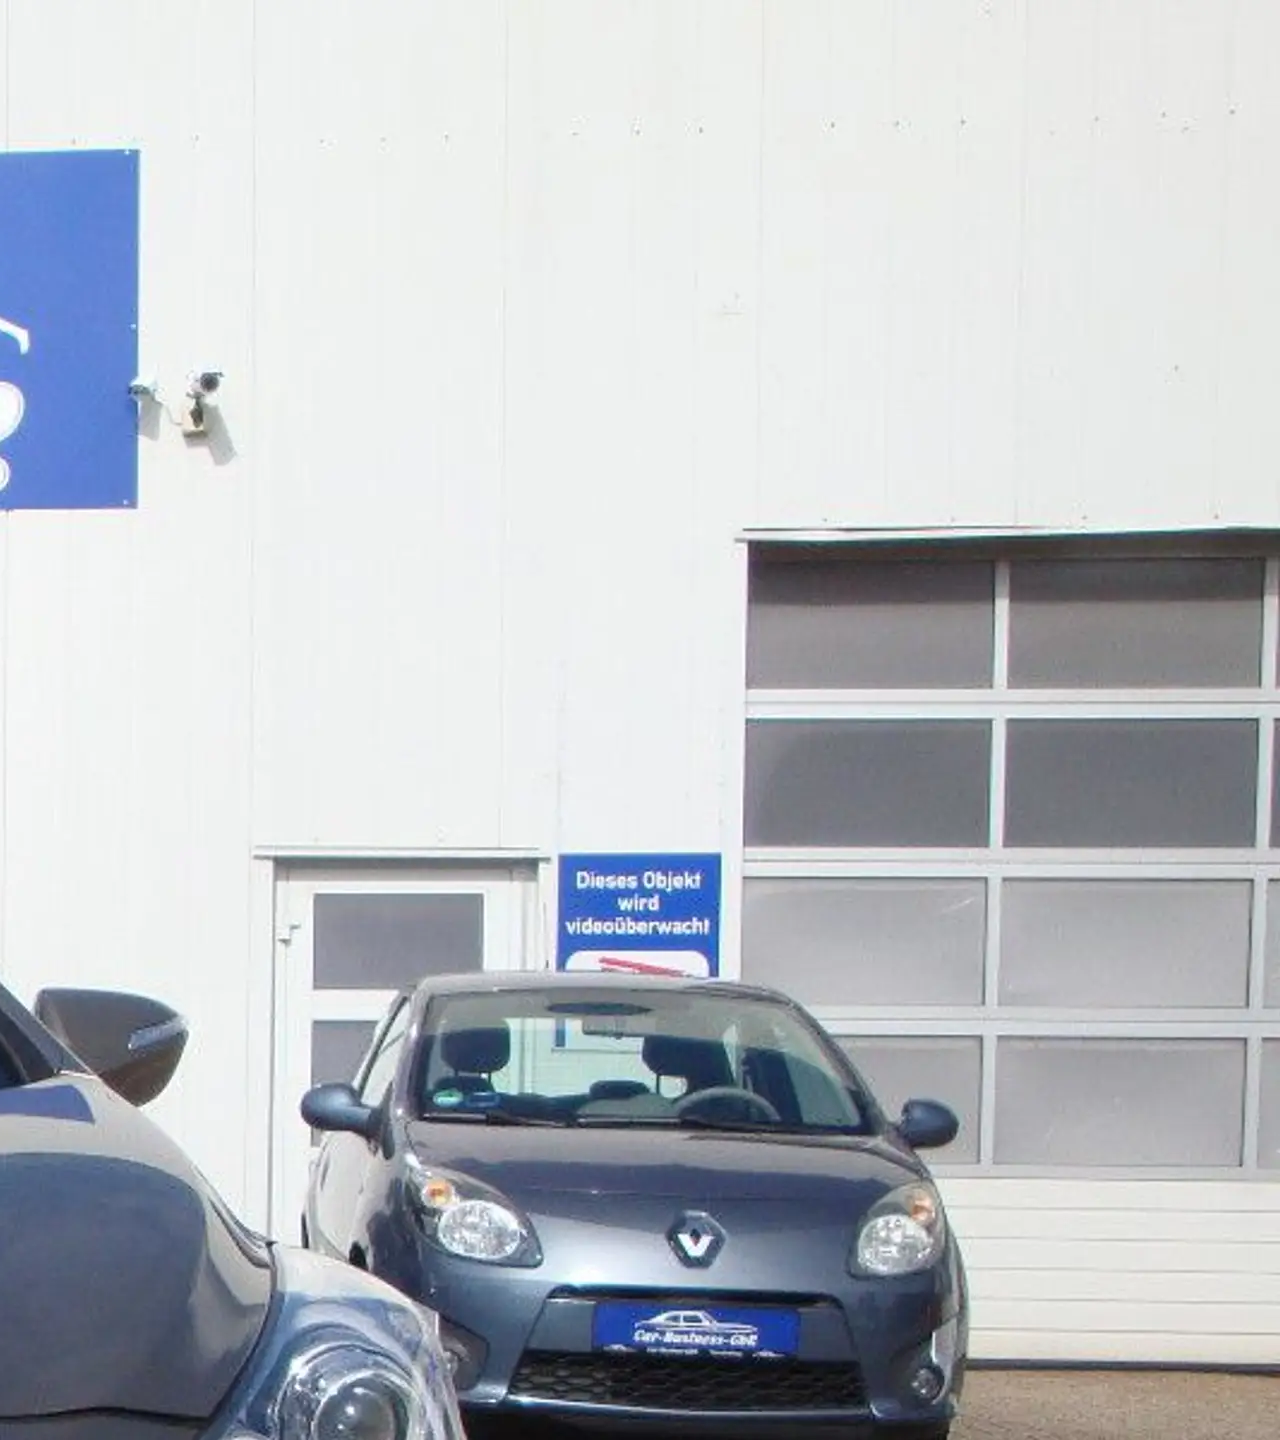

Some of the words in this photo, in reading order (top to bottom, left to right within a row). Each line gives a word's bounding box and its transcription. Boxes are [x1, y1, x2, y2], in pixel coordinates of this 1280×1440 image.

[576, 871, 638, 889] Dieses
[643, 871, 702, 892] Objekt
[617, 894, 660, 911] wird
[565, 917, 710, 935] videoüberwacht
